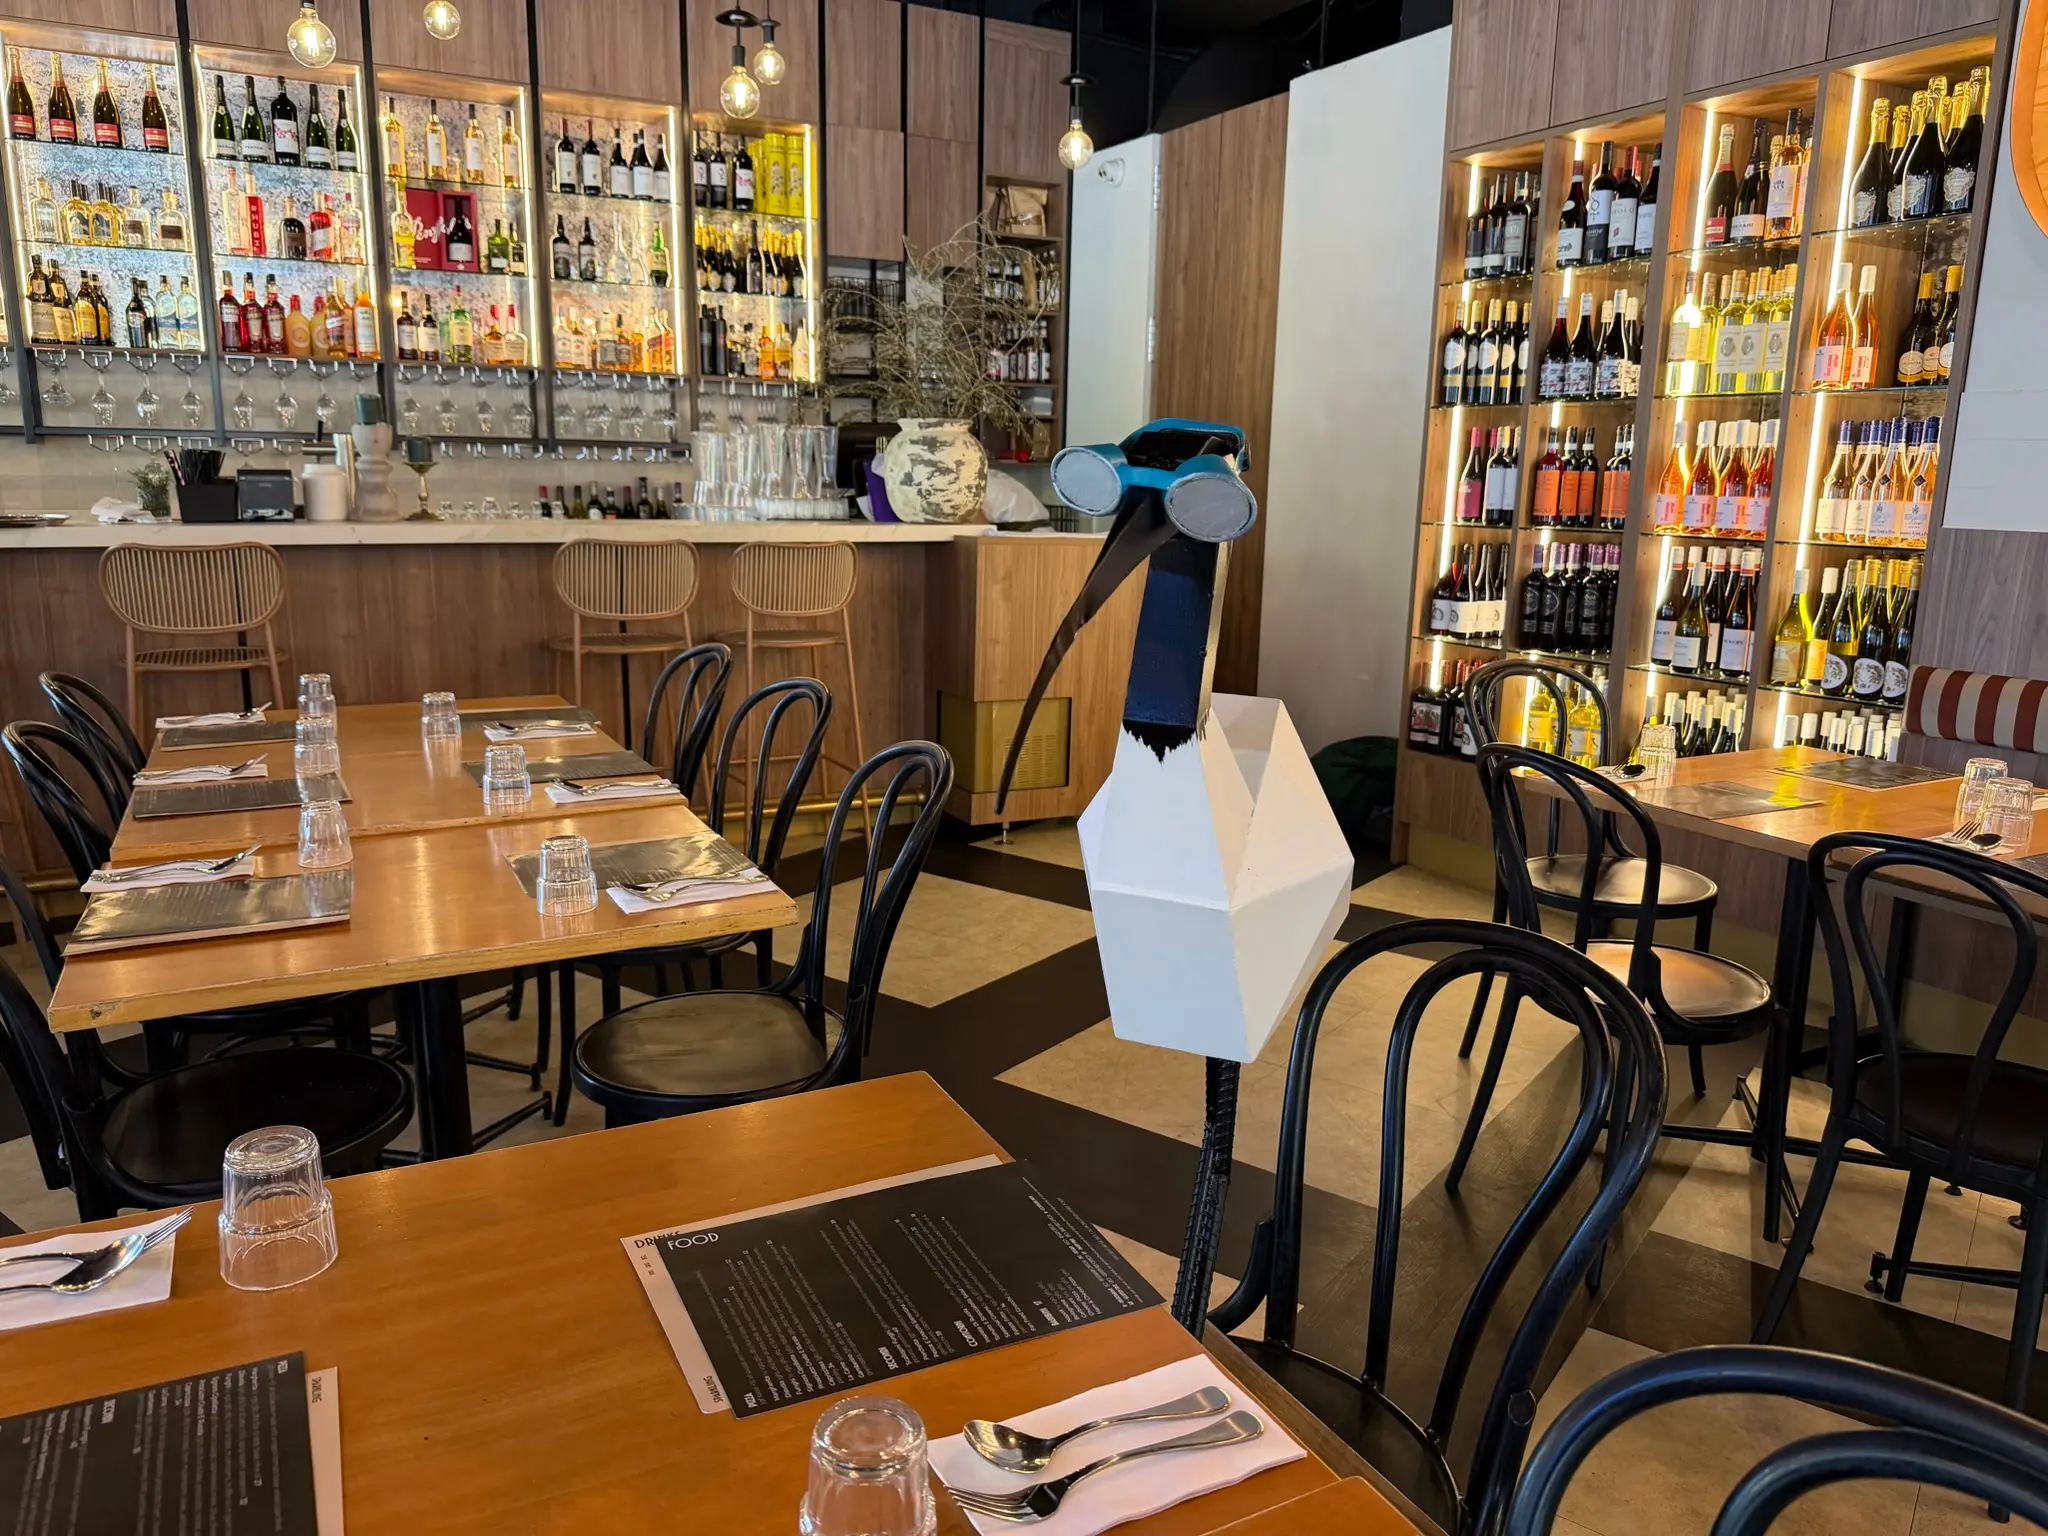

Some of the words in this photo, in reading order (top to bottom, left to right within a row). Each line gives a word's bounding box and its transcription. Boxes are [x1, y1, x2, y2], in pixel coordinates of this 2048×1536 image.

[667, 1232, 720, 1251] FOOD
[952, 1320, 979, 1347] CONTORNI
[877, 1346, 900, 1370] SECONDI
[742, 1392, 758, 1408] PIZZA
